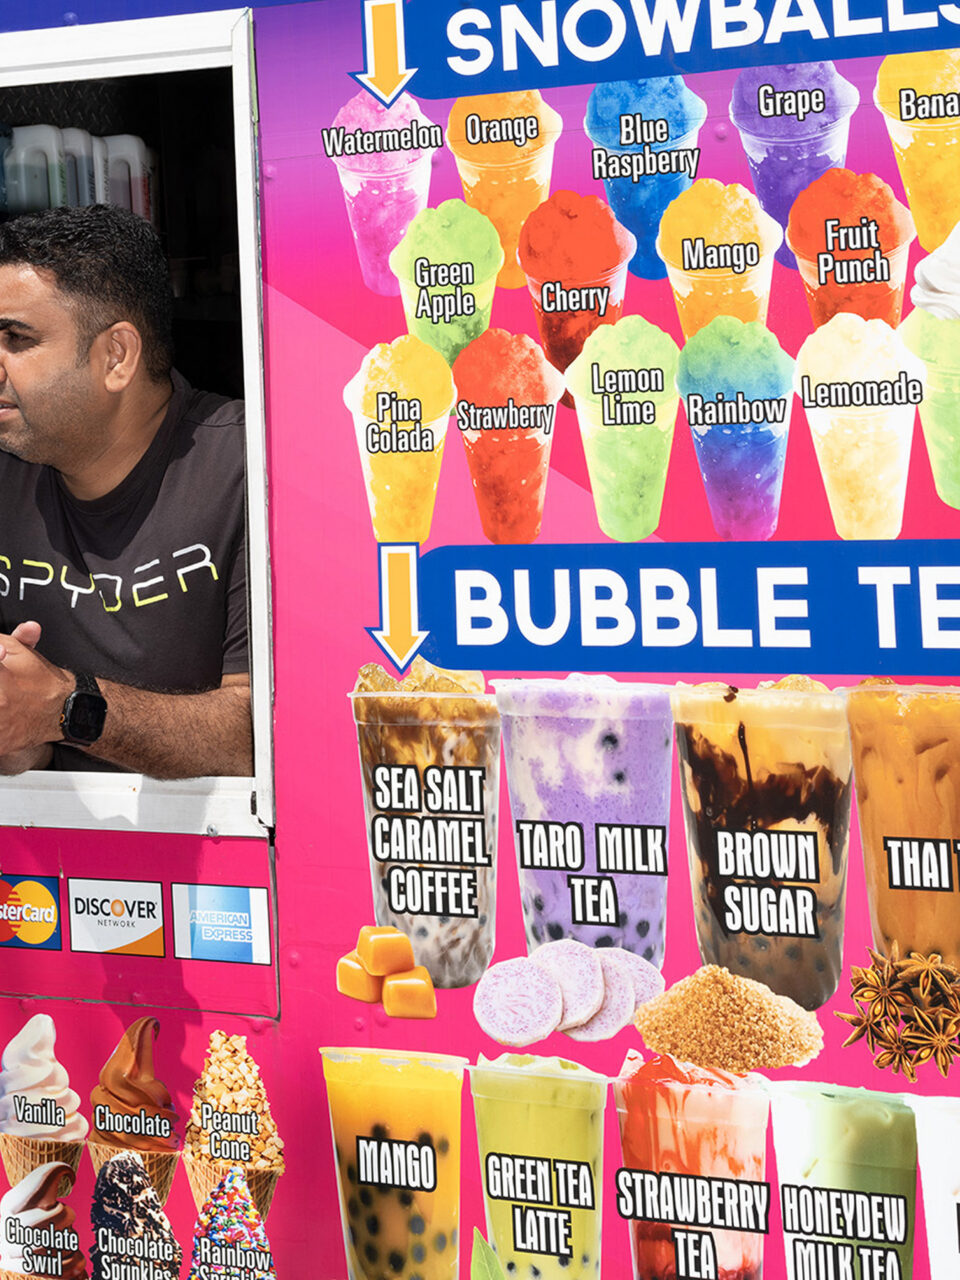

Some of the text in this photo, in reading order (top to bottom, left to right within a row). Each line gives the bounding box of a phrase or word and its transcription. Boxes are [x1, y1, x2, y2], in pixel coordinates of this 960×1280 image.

[758, 85, 825, 120] Grape
[322, 121, 443, 157] Watermelon
[466, 113, 538, 146] Orange
[620, 115, 668, 145] Blue
[592, 147, 700, 182] Raspberry
[825, 218, 880, 251] Fruit
[415, 258, 474, 287] Green
[682, 238, 759, 273] Mango
[818, 251, 890, 285] Punch
[416, 287, 475, 323] Apple
[542, 282, 609, 316] Cherry
[592, 364, 663, 394] Lemon
[802, 372, 923, 408] Lemonade
[376, 393, 422, 422] Pina
[457, 399, 554, 434] Strawberry
[602, 395, 655, 425] Lime
[688, 392, 786, 425] Rainbow
[366, 424, 433, 453] Colada
[454, 567, 812, 648] BUBBLE
[374, 765, 484, 814] SEA SALT
[372, 816, 490, 865] CARAMEL
[518, 822, 666, 873] TARO MILK
[716, 830, 818, 882] BROWN
[886, 839, 951, 890] THAI
[75, 897, 156, 919] DISCOVER
[389, 868, 477, 916] COFFEE
[570, 877, 617, 924] TEA
[97, 919, 136, 928] NETWORK
[189, 911, 249, 926] AMERICAN
[722, 884, 817, 936] SUGAR
[203, 927, 253, 942] EXPRESS
[13, 1095, 65, 1126] Vanilla
[94, 1104, 171, 1138] Chocolate
[201, 1104, 259, 1135] Peanut
[210, 1132, 250, 1161] Cone
[357, 1138, 436, 1191] MANGO
[487, 1154, 594, 1209] GREEN TEA
[617, 1169, 770, 1232] STRAWBERRY
[782, 1185, 907, 1243] HONEYDEW
[5, 1217, 78, 1251] Chocolate
[98, 1227, 174, 1262] Chocolate
[513, 1206, 572, 1256] LATTE
[22, 1248, 63, 1276] Swirl
[100, 1255, 172, 1280] Sprinkles
[199, 1237, 272, 1271] Rainbow
[673, 1230, 718, 1280] TEA
[794, 1238, 901, 1280] MILK TEA
